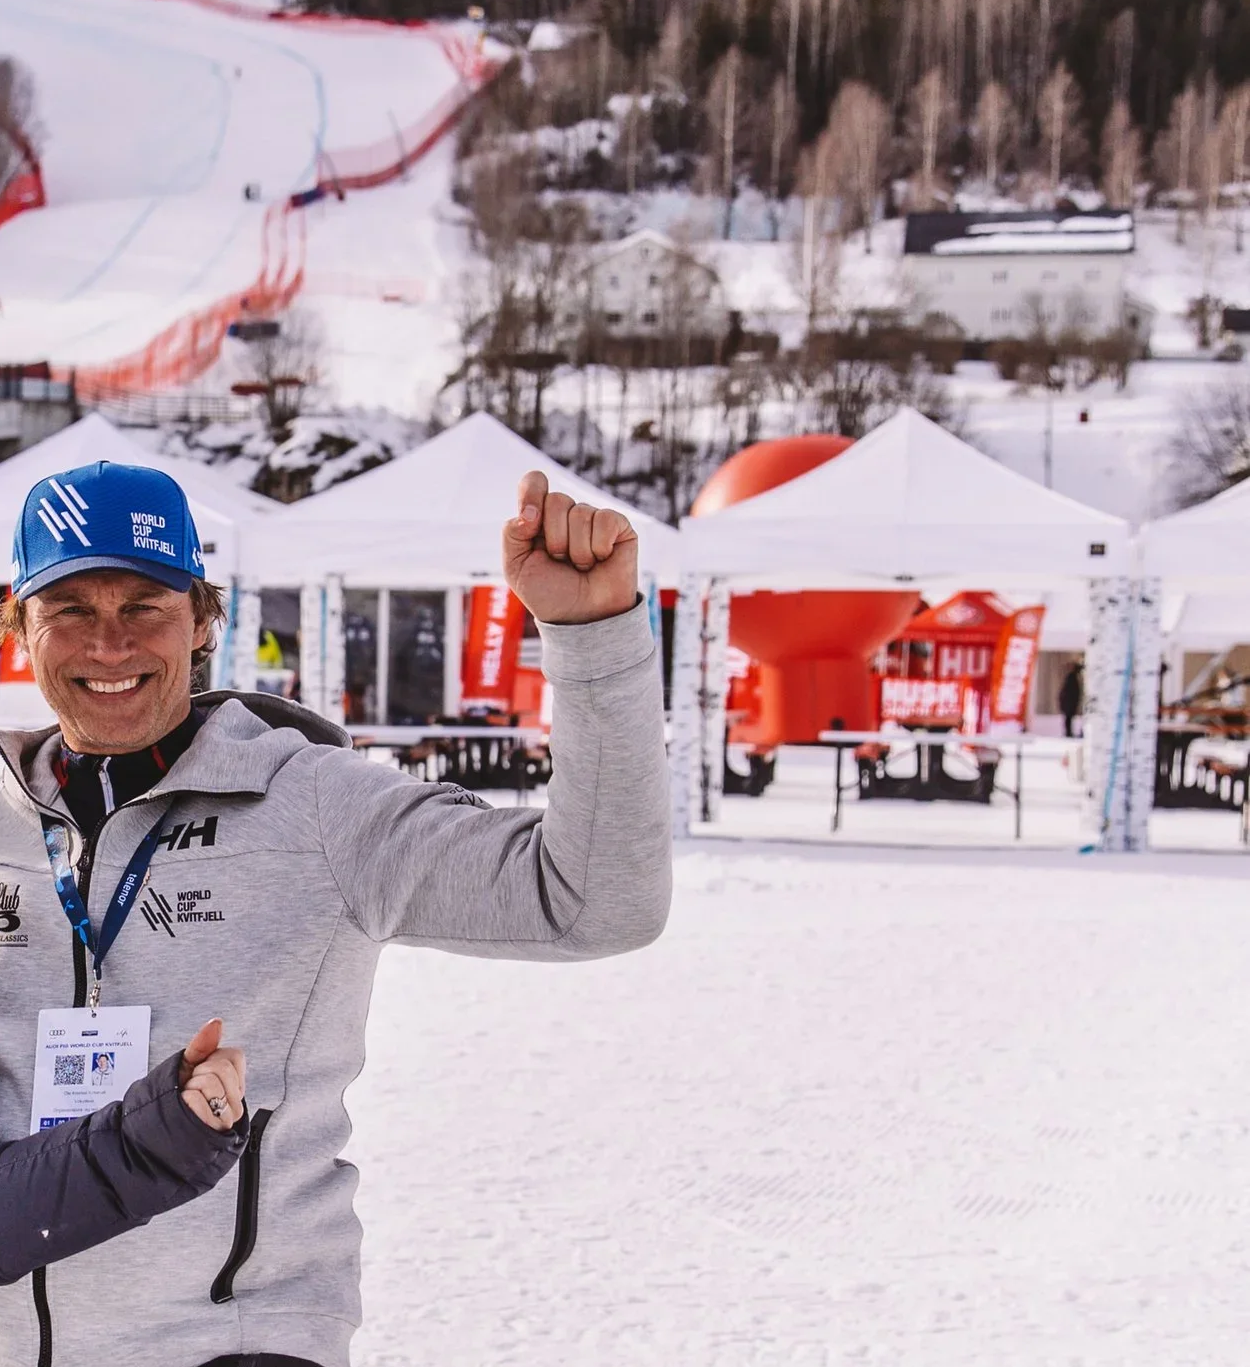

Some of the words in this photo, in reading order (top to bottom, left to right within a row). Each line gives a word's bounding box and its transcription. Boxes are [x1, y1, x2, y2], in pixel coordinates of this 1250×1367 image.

[130, 512, 166, 529] WORLD
[132, 524, 153, 537] CUP
[133, 536, 177, 558] KVITFJELL
[117, 873, 138, 907] telenor
[177, 890, 211, 902] WORLD
[177, 901, 196, 912] CUP
[177, 911, 225, 923] KVITFJELL
